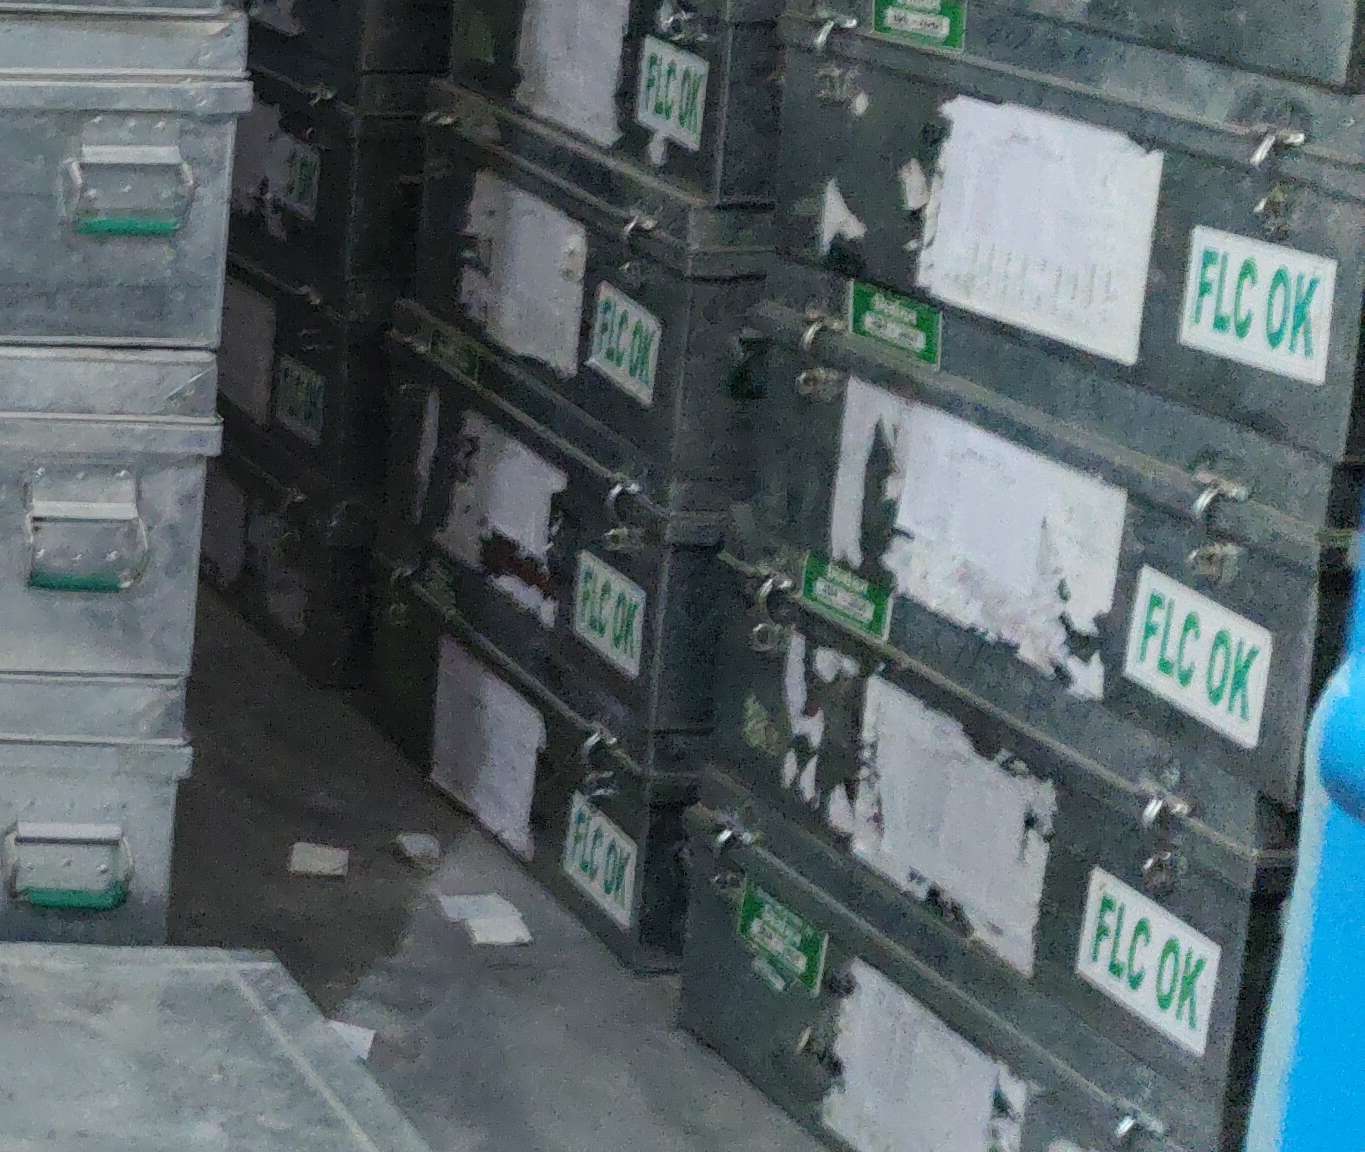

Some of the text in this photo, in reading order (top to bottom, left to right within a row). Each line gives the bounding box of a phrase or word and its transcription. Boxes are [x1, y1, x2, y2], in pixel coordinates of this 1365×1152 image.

[1193, 246, 1321, 358] FLC OK
[1136, 589, 1260, 722] FLC OK
[1089, 894, 1207, 1030] FLC OK
